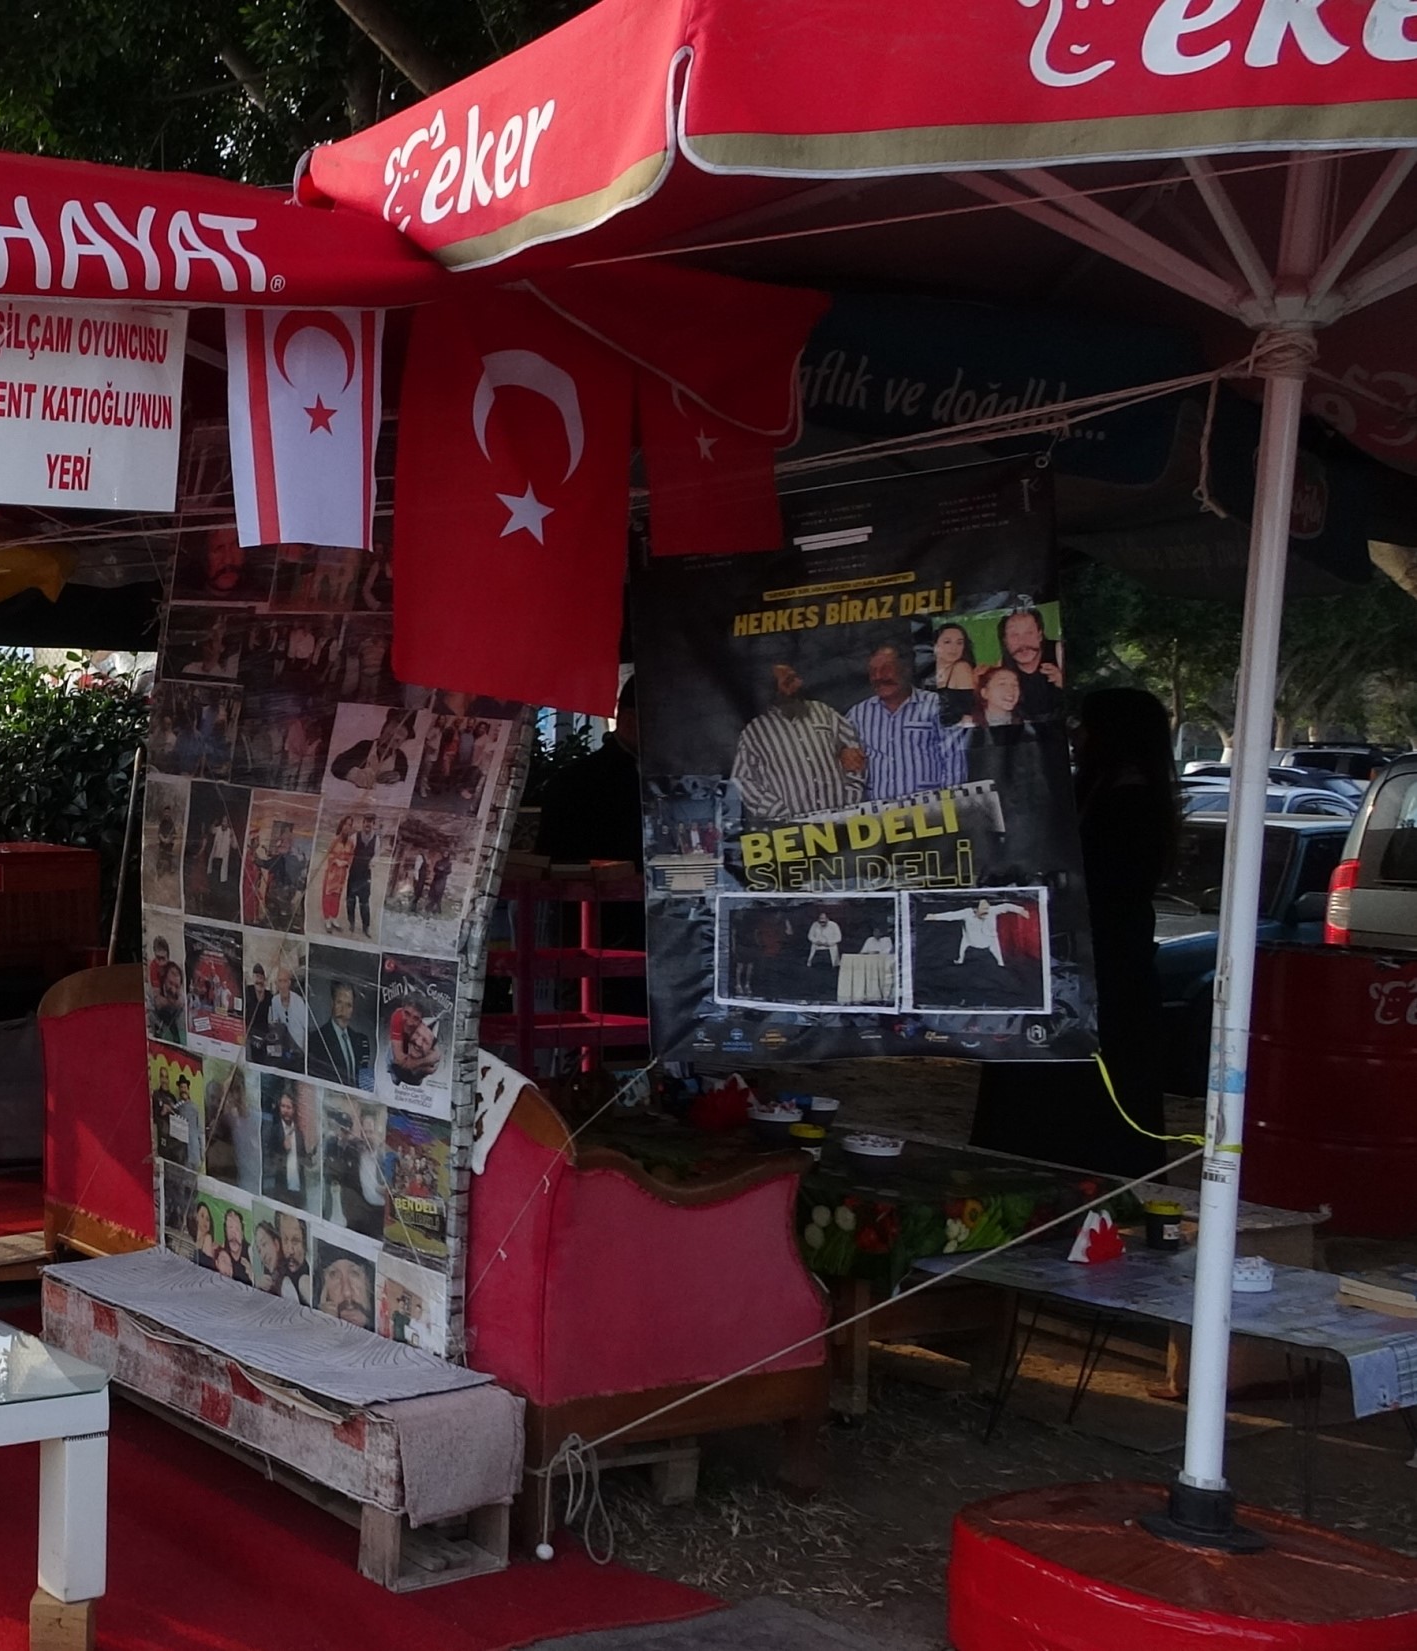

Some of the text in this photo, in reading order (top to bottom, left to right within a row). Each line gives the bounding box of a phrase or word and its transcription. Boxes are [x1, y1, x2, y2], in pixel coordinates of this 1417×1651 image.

[420, 99, 556, 224] eker
[78, 318, 169, 364] OYUNCUSU
[42, 381, 172, 430] KATIOĞLU'NUN
[799, 349, 873, 410] aflık
[884, 376, 927, 416] ve
[46, 448, 92, 491] YERİ
[733, 604, 820, 637] HERKES
[824, 594, 895, 626] BİRAZ
[899, 580, 955, 617] DELİ
[740, 789, 960, 867] BEN DELİ
[745, 838, 975, 893] SEN DELİ
